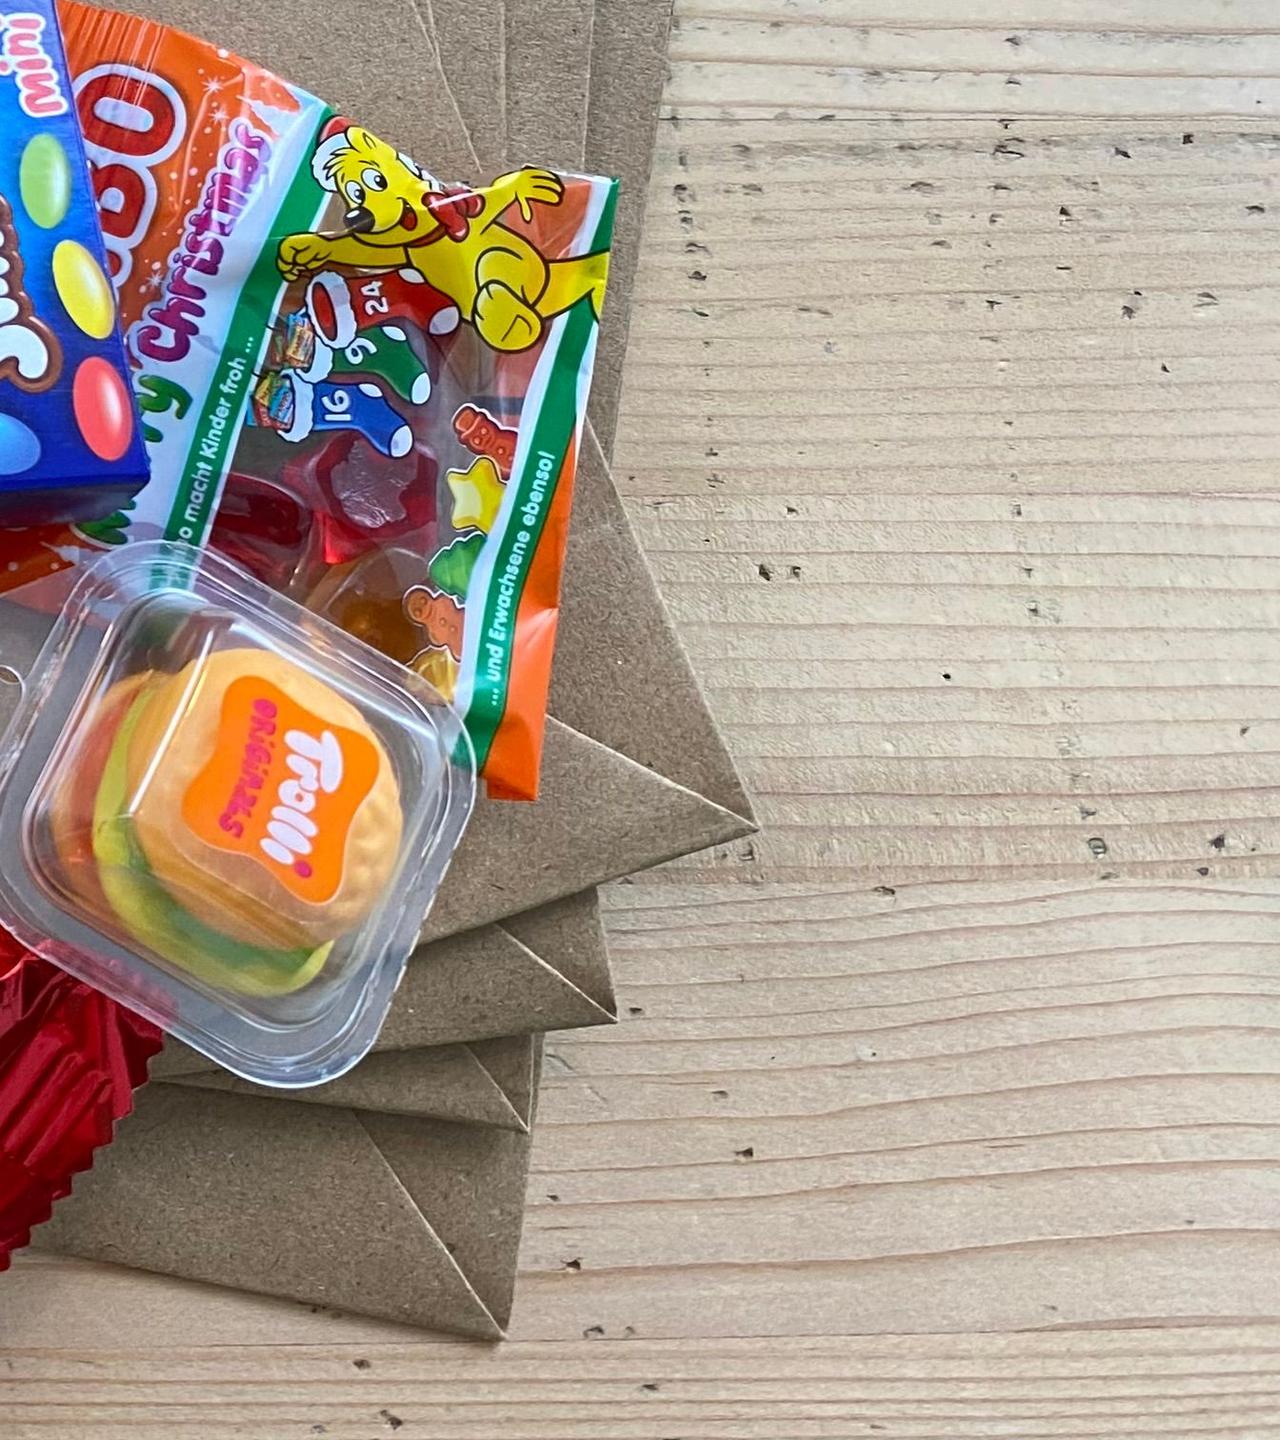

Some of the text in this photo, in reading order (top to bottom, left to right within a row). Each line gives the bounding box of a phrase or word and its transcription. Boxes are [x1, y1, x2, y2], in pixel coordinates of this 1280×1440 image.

[137, 122, 269, 362] Christmas
[360, 280, 389, 316] 24
[184, 461, 213, 522] macht
[200, 397, 232, 459] Kinder
[219, 357, 247, 395] froh
[320, 388, 353, 423] 16
[522, 450, 557, 527] ebenso!
[489, 530, 531, 642] Erwachsene
[486, 643, 504, 682] und
[259, 729, 343, 879] Trolli
